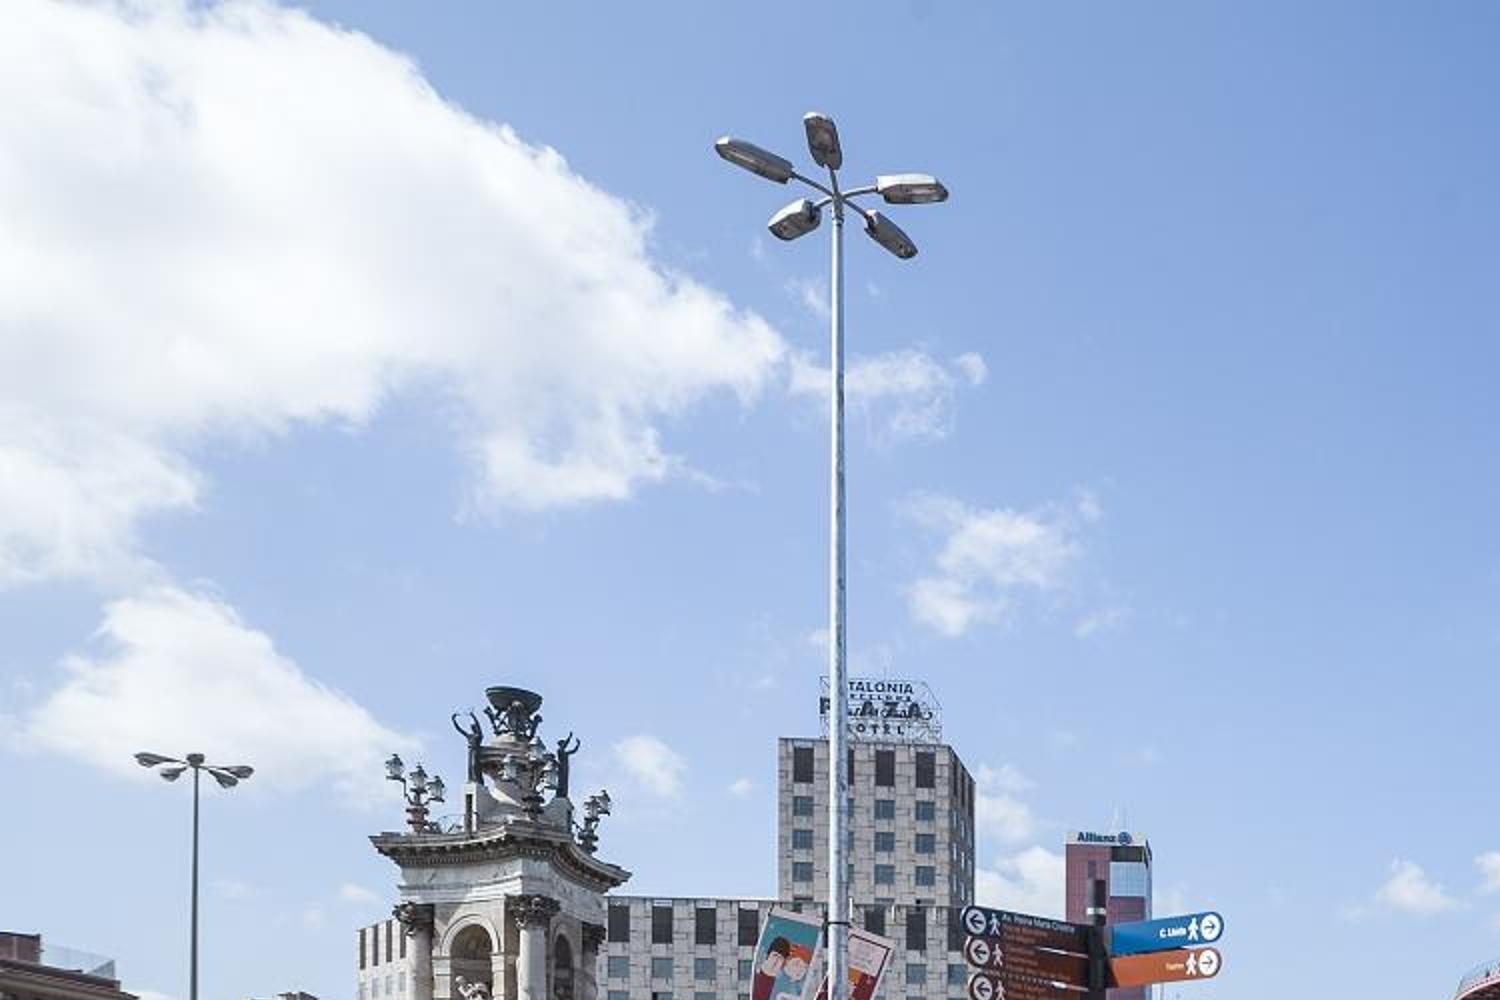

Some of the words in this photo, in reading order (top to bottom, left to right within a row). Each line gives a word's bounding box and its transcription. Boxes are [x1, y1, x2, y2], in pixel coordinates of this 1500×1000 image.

[848, 681, 914, 694] TALONIA
[819, 697, 923, 718] PAZA
[848, 722, 905, 735] OTEL
[1077, 831, 1116, 842] Allianz
